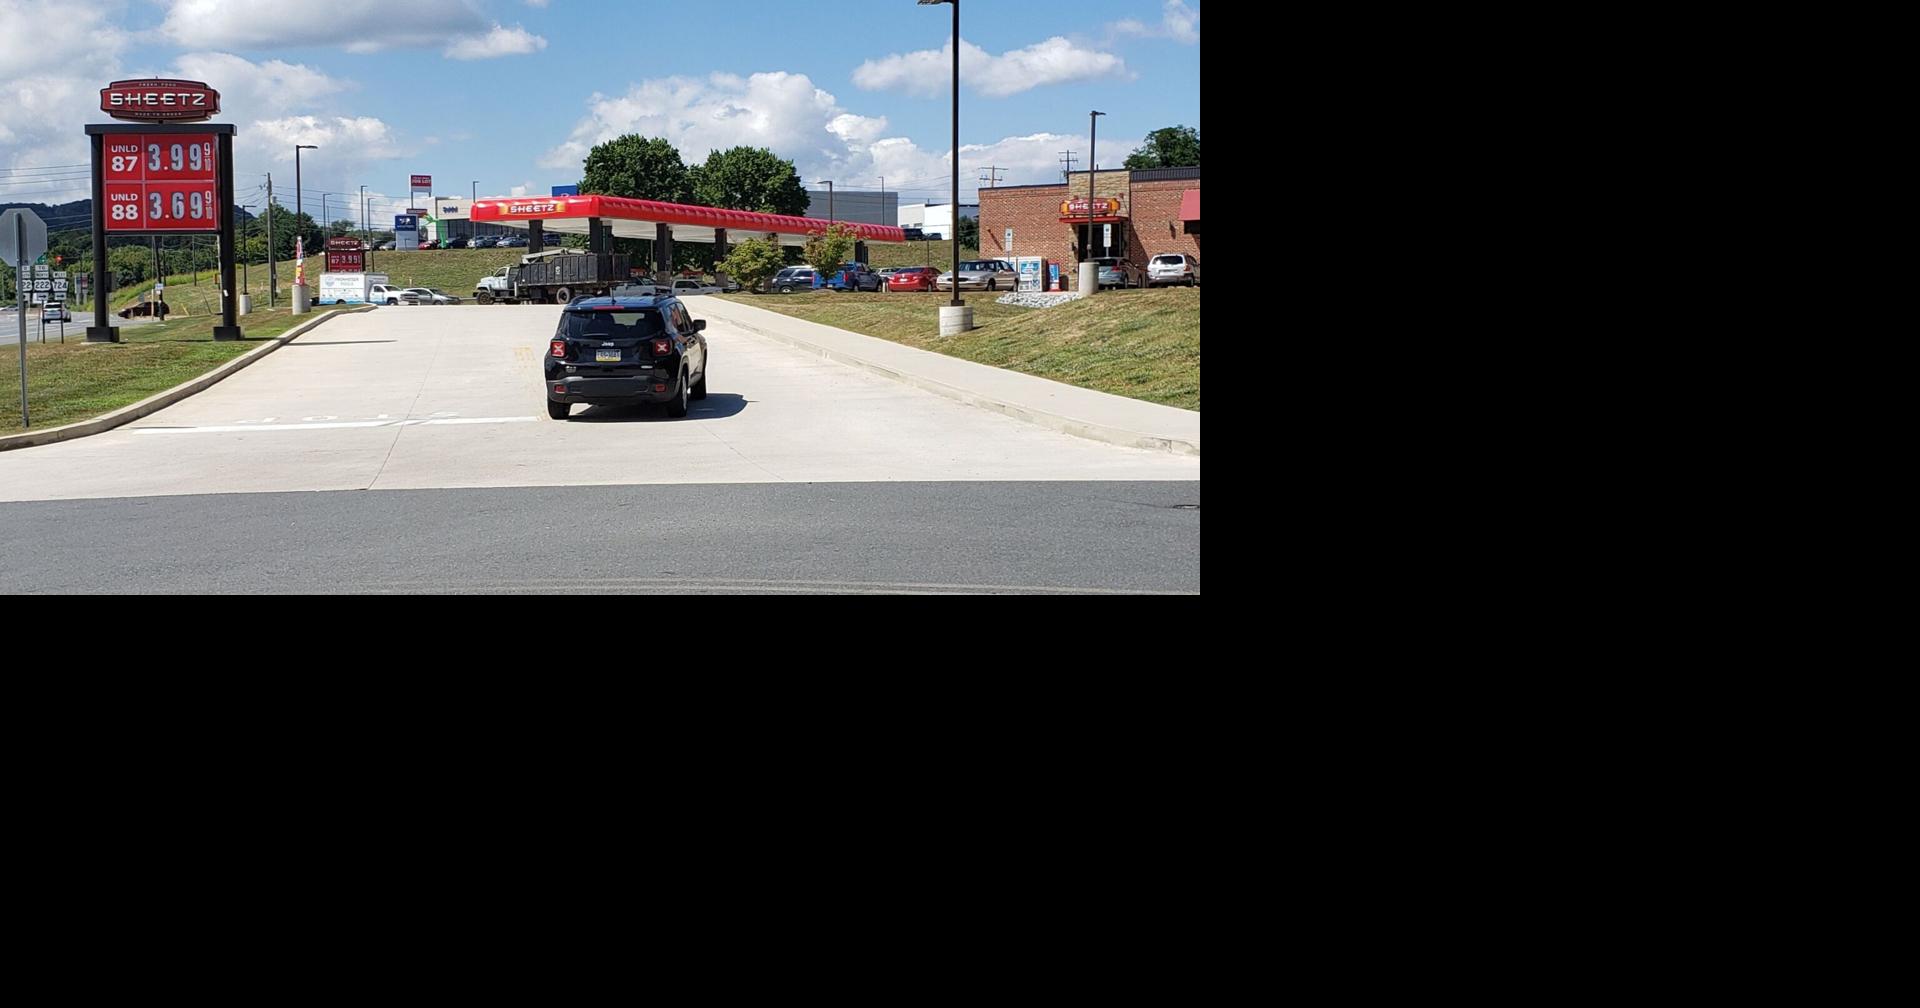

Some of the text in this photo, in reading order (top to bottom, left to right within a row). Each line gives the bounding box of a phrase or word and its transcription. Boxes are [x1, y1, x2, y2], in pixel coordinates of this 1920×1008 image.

[110, 92, 206, 106] SHEETZ
[111, 145, 138, 153] UNLD
[148, 143, 202, 171] 3.99
[112, 156, 138, 172] 87
[111, 193, 138, 201] UNLD
[149, 192, 203, 219] 3.69
[510, 204, 555, 213] SHEETZ
[112, 204, 138, 220] 88
[35, 281, 50, 289] 222
[53, 281, 67, 289] 724
